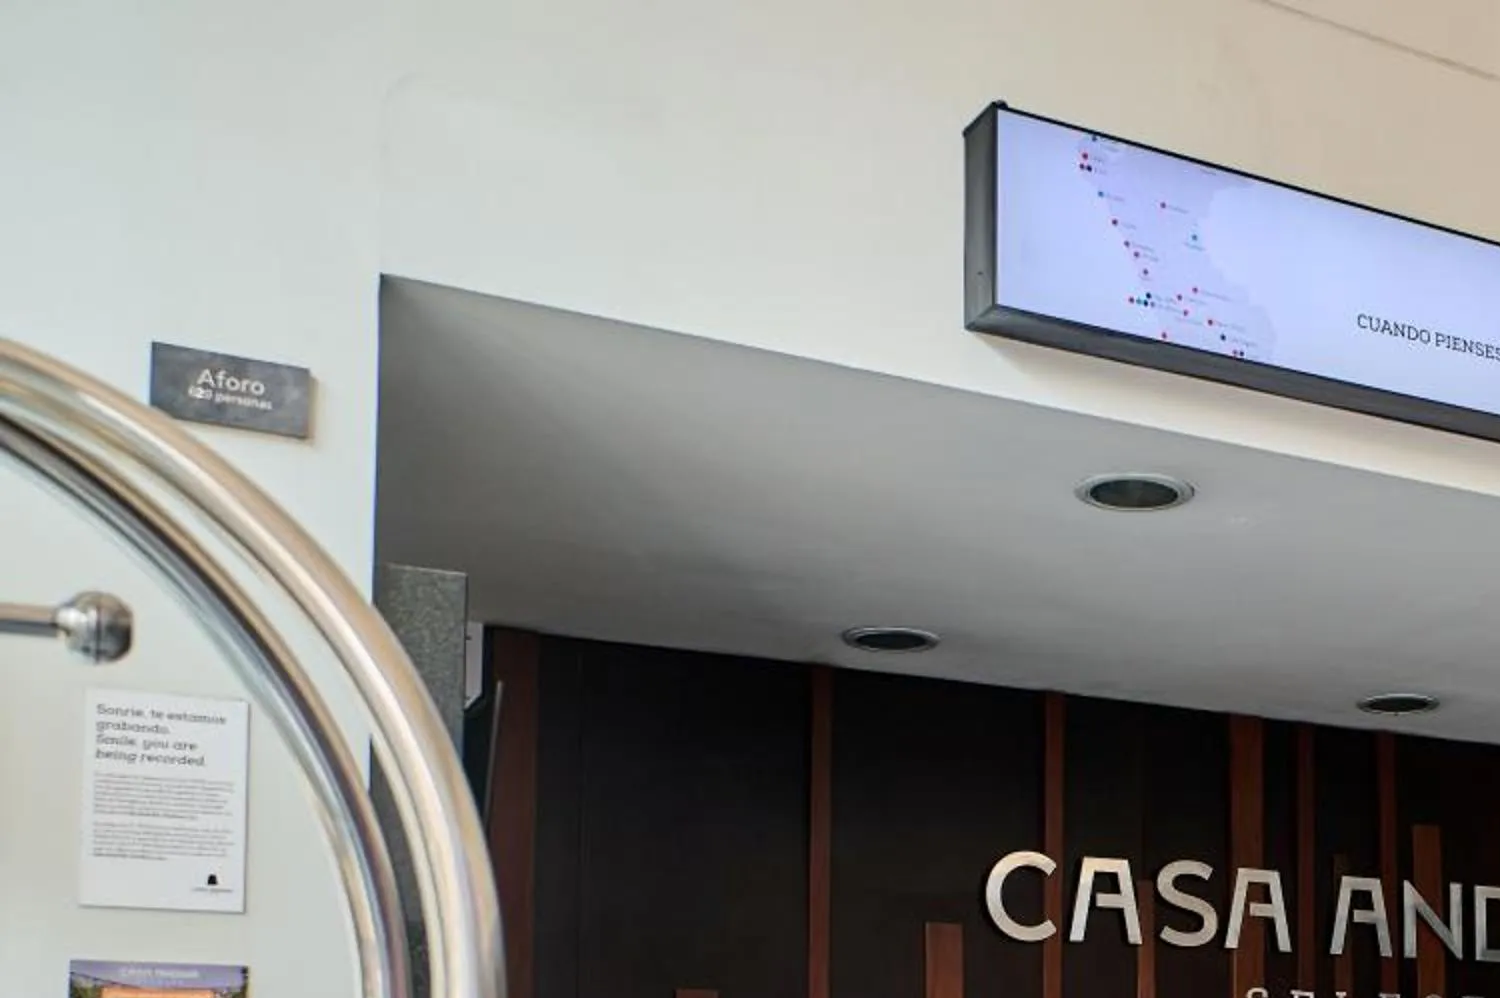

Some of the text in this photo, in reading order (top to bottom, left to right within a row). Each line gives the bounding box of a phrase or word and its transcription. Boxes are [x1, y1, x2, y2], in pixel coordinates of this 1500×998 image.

[1356, 313, 1431, 344] CUANDO
[196, 368, 265, 396] Aforo
[986, 850, 1292, 953] CASA
